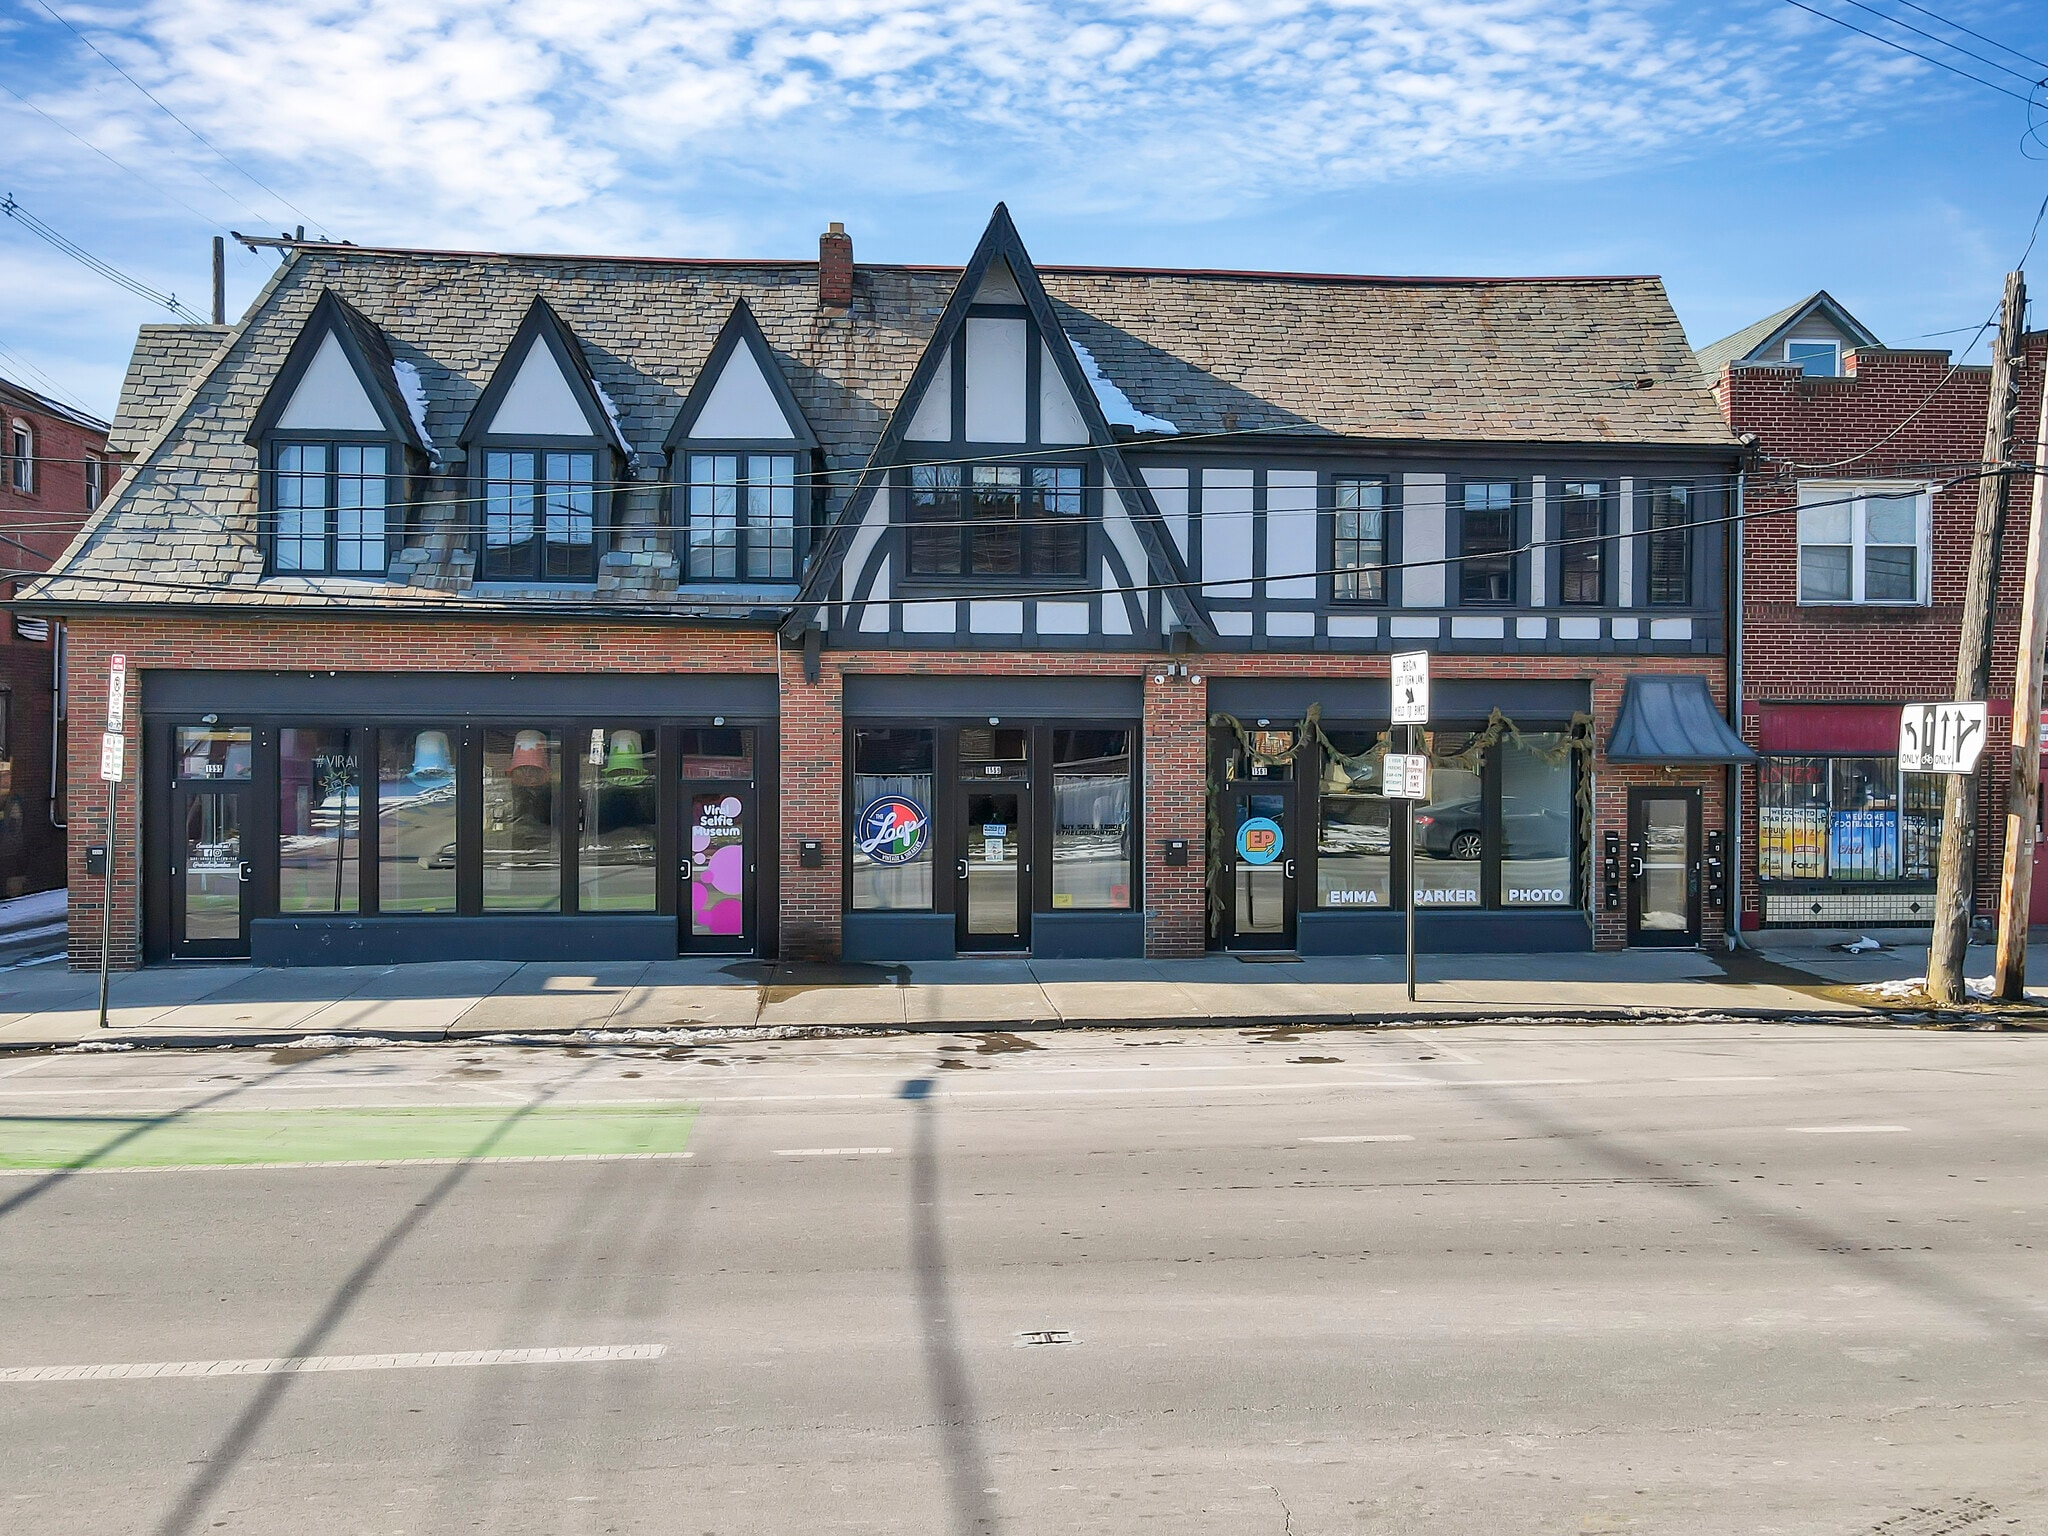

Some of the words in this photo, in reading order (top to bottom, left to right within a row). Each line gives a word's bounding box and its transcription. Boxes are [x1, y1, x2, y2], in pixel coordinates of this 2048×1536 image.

[1402, 660, 1417, 672] BEGIN
[1411, 758, 1419, 766] NO
[1902, 753, 1919, 764] ONLY
[1935, 754, 1952, 765] ONLY
[703, 804, 730, 816] Viral
[700, 815, 734, 826] Selfie
[1845, 813, 1884, 821] WELCOME
[1834, 820, 1874, 828] FOOTBALL
[1875, 820, 1895, 828] FANS
[693, 826, 741, 837] Museum
[860, 811, 928, 853] Loop
[1245, 829, 1277, 853] EP
[1330, 889, 1377, 903] EMMA
[1414, 889, 1477, 902] PARKER
[1508, 889, 1564, 902] PHOTO
